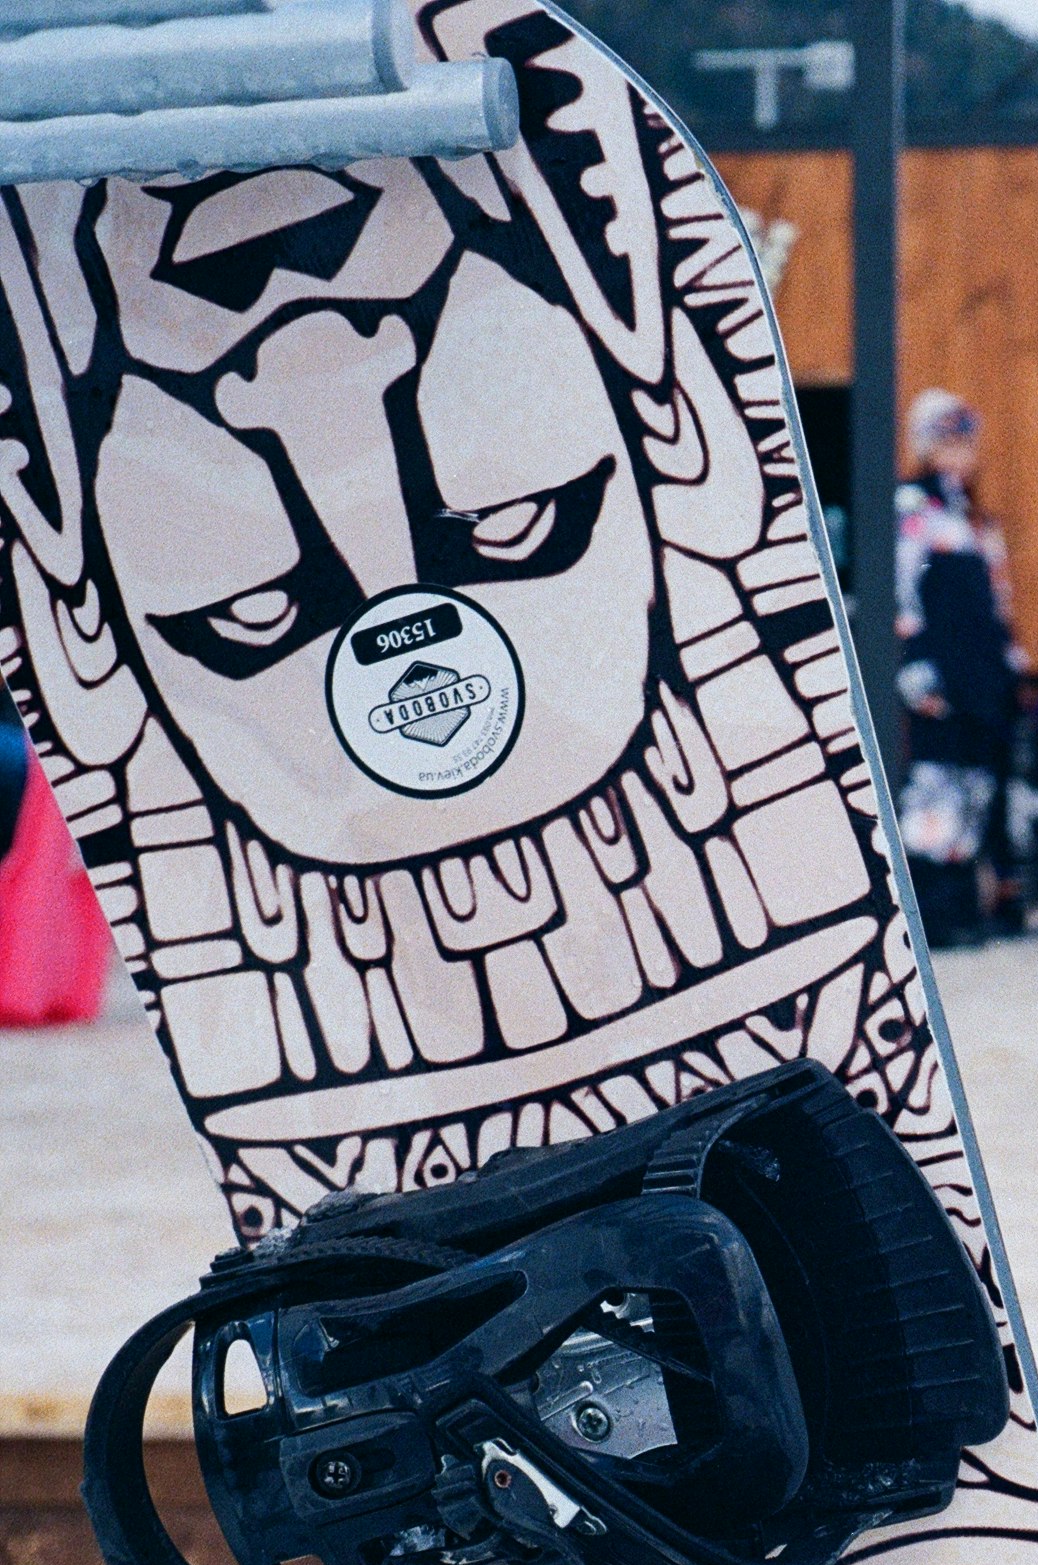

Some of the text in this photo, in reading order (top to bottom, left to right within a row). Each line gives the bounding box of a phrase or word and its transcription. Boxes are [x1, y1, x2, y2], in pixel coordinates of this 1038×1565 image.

[376, 618, 436, 653] 15306
[384, 682, 477, 725] SVOBODA
[418, 686, 510, 783] www.svoboda.kiev.ua
